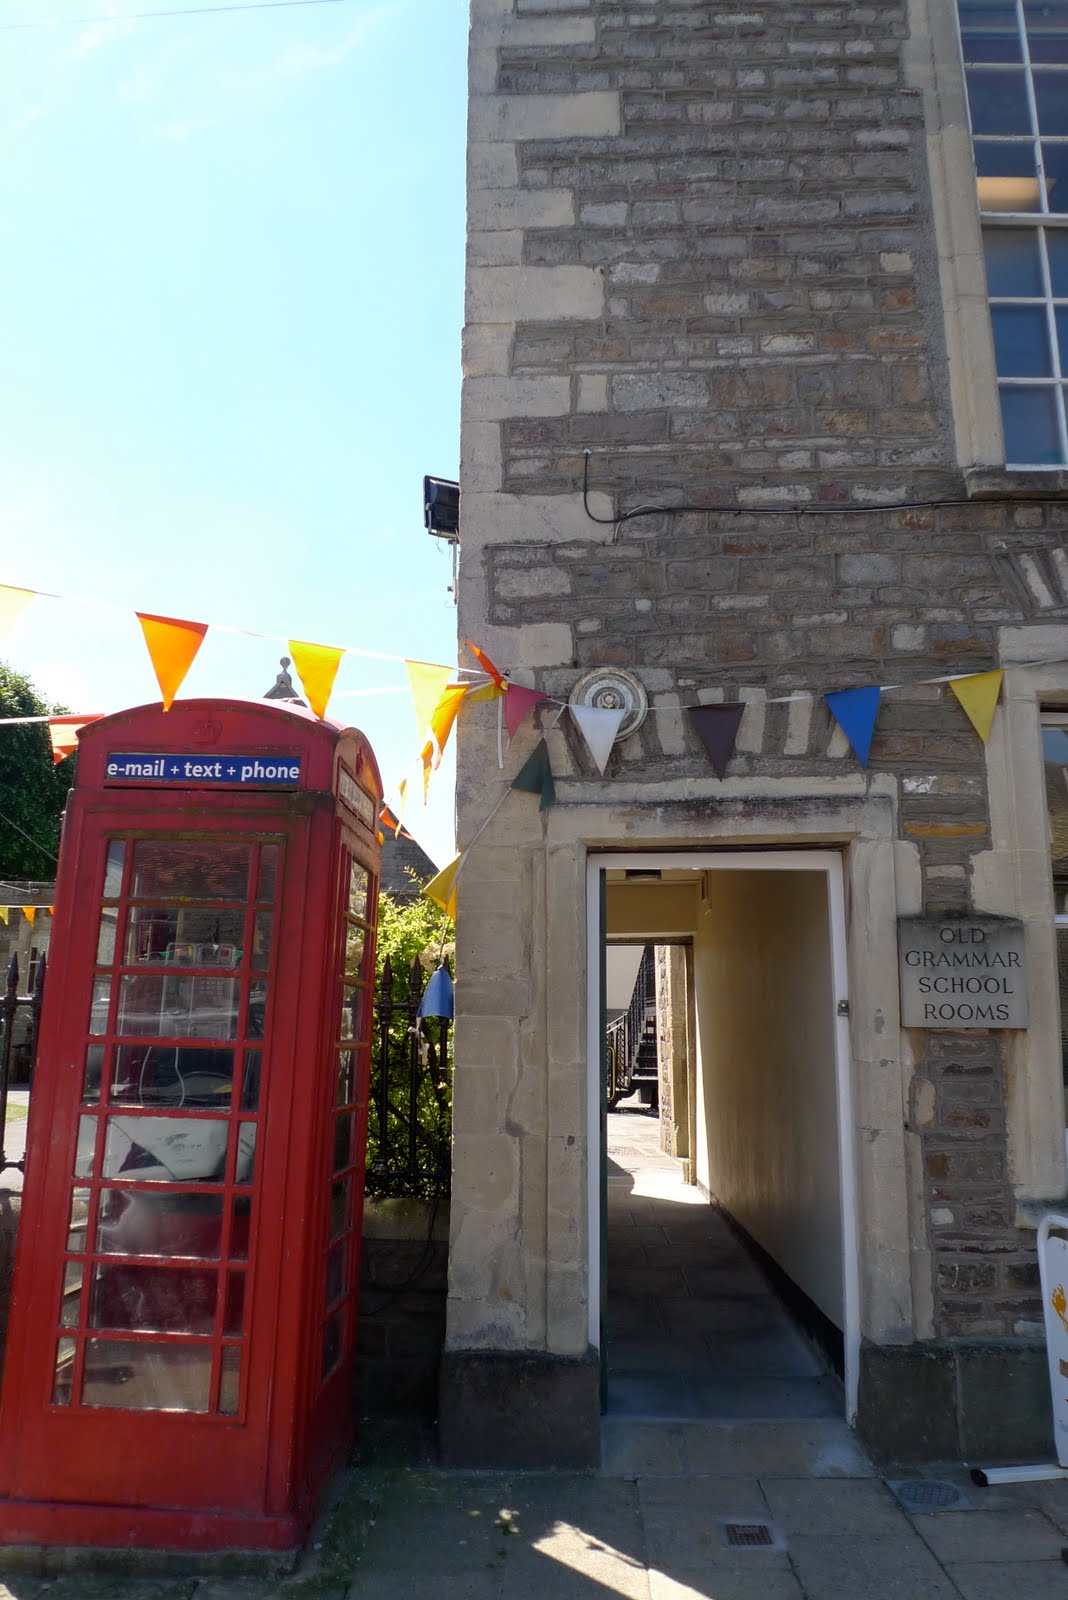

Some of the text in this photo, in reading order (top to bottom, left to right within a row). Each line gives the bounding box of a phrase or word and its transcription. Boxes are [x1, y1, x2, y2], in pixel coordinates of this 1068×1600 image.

[107, 760, 300, 781] e-mail + text + phone
[940, 928, 985, 943] OLD
[905, 950, 1021, 967] GRAMMAR
[919, 977, 1014, 993] SCHOOL
[924, 1004, 1010, 1020] ROOMS
